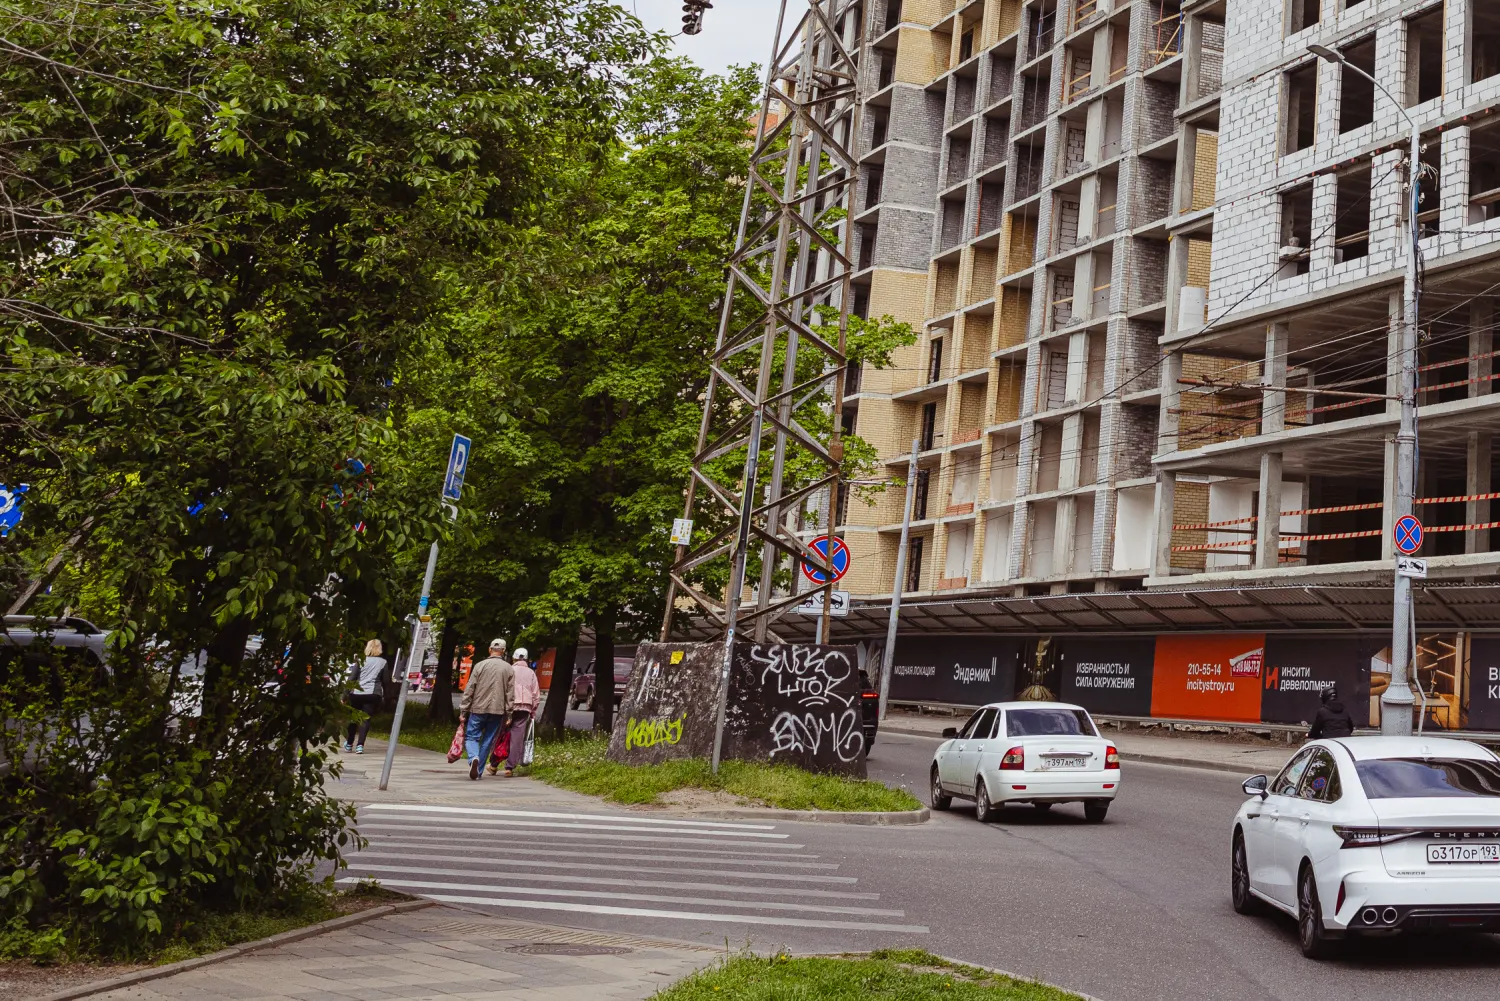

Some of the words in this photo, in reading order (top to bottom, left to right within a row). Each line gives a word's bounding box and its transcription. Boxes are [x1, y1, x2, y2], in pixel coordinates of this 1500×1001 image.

[894, 665, 913, 677] МОДНАЯ
[913, 666, 936, 678] ЛОКАЦИЯ
[953, 662, 991, 684] Эндемик
[1076, 662, 1123, 675] ИЗБРАННОСТЬ
[1124, 663, 1130, 675] И
[1187, 663, 1222, 676] 210-55-14
[1281, 666, 1311, 678] ИНСИТИ
[1075, 676, 1093, 688] СИЛА
[1093, 676, 1135, 689] ОКРУЖЕНИЯ
[1186, 678, 1235, 694] incitystroy.ru
[1431, 846, 1478, 860] О317ОР
[1480, 845, 1497, 856] 193
